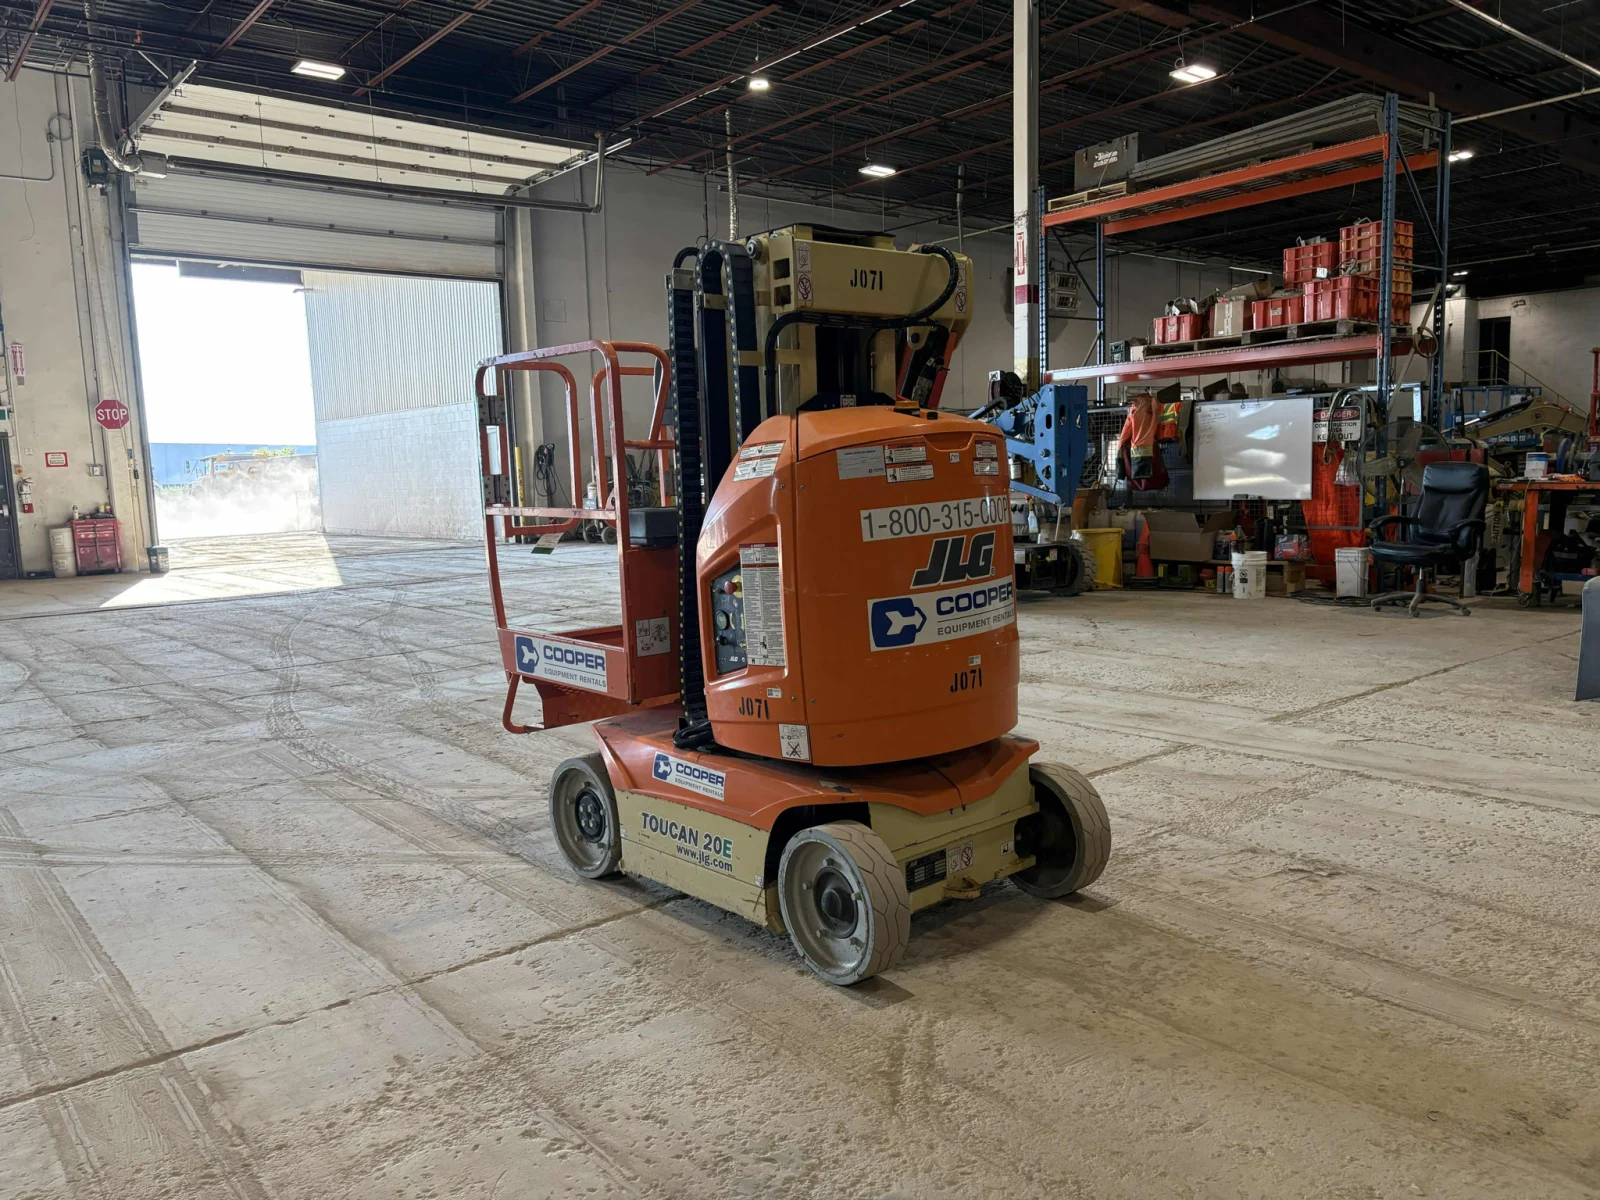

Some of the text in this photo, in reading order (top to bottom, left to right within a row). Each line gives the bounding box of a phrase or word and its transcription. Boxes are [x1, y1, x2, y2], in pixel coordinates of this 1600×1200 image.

[850, 269, 883, 291] J071
[97, 408, 128, 421] STOP
[863, 497, 1008, 538] 1-800-315-COOP
[910, 531, 996, 589] JLG
[936, 582, 1013, 616] COOPER
[937, 609, 1015, 636] EQUIPMENT RENTALS
[543, 645, 606, 672] COOPER
[544, 667, 607, 688] EQUIPMENT RENTALS
[950, 668, 982, 693] J071
[739, 696, 770, 720] J071
[675, 763, 725, 787] COOPER
[675, 777, 724, 798] EQUIPMENT RENTALS
[641, 812, 733, 859] TOUCAN 20E
[676, 844, 733, 873] www.jlg.com
